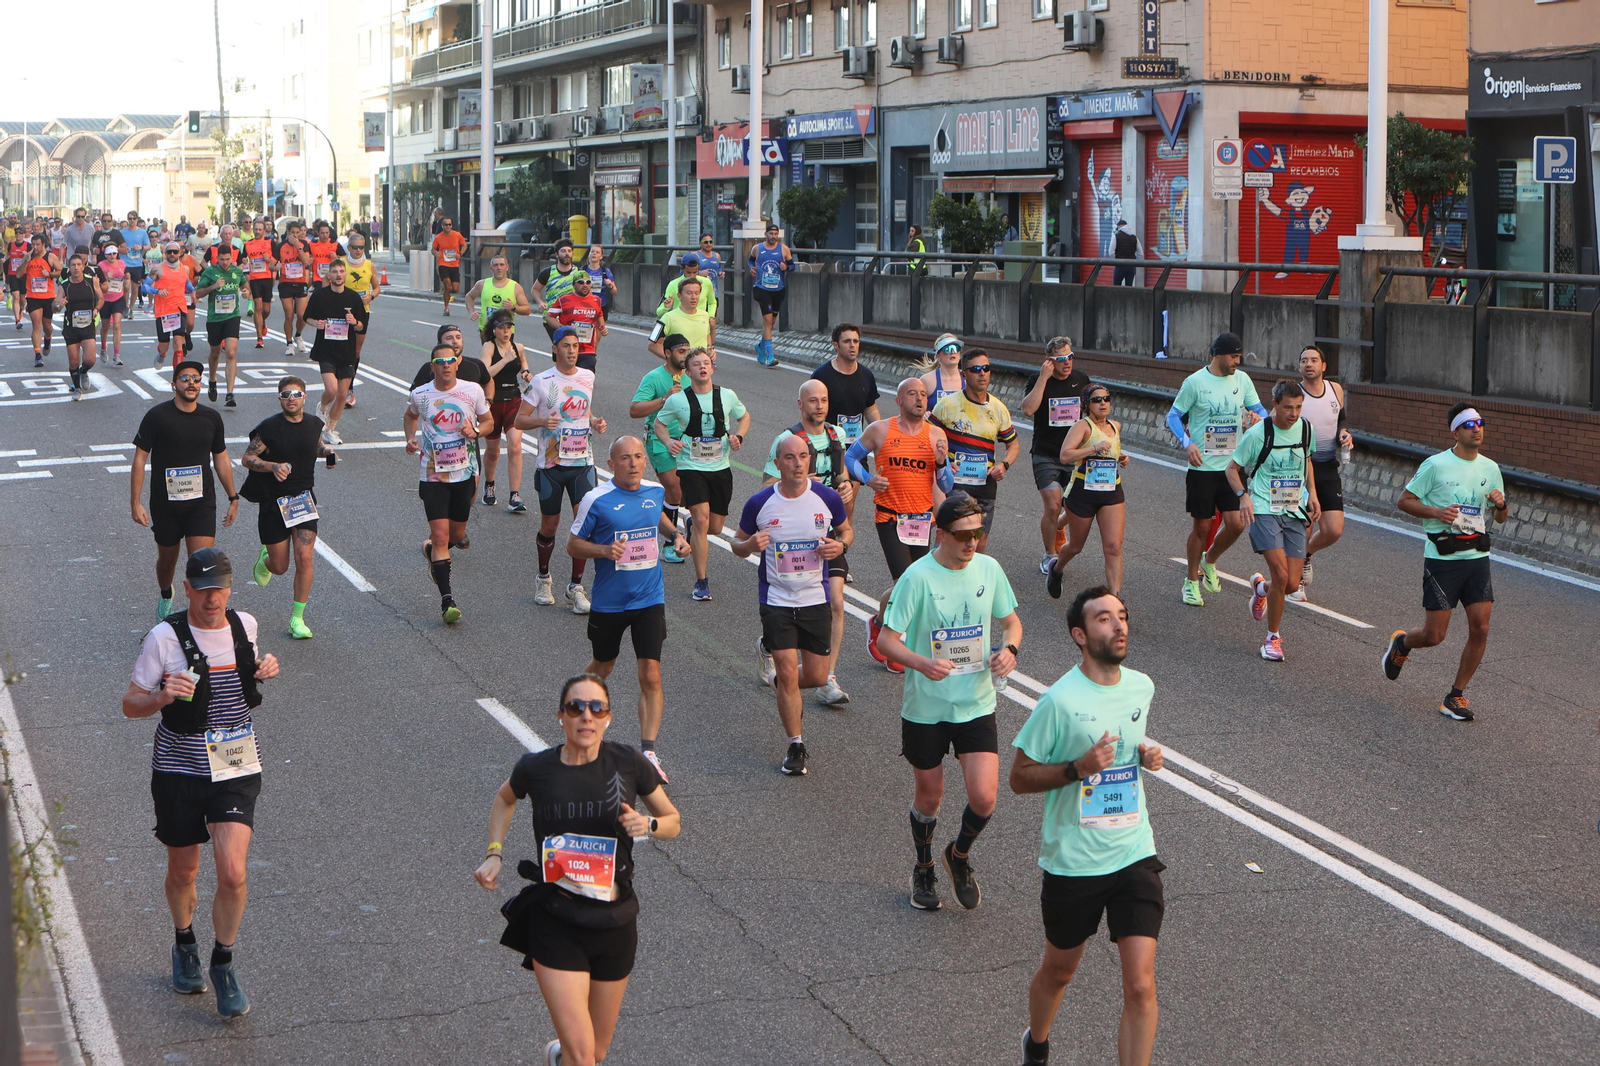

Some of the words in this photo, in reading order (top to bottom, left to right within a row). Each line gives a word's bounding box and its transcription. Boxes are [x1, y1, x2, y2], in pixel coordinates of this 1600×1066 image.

[1130, 63, 1173, 73] HOSTAL
[1224, 71, 1290, 81] BENIDORM
[1485, 76, 1522, 98] Origen
[1525, 84, 1549, 93] Servicios
[1550, 82, 1582, 92] Financieros
[1084, 98, 1111, 114] JIMENEZ
[799, 121, 827, 133] AUTOCLIMA
[1289, 144, 1326, 159] Jiménez
[1328, 144, 1354, 157] Maña
[1544, 144, 1568, 178] P
[1291, 167, 1339, 176] RECAMBIOS
[889, 457, 926, 469] IVECO
[630, 531, 652, 539] ZURICH
[951, 629, 977, 638] ZURICH
[949, 646, 969, 654] 10265
[225, 727, 247, 739] ZURICH
[225, 746, 244, 756] 10422
[229, 758, 243, 766] JACK
[1105, 771, 1133, 782] ZURICH
[1104, 793, 1122, 802] 5491
[568, 801, 604, 819] DIRT
[569, 839, 606, 851] ZURICH
[568, 859, 590, 870] 1024
[565, 872, 594, 883] ULIANA
